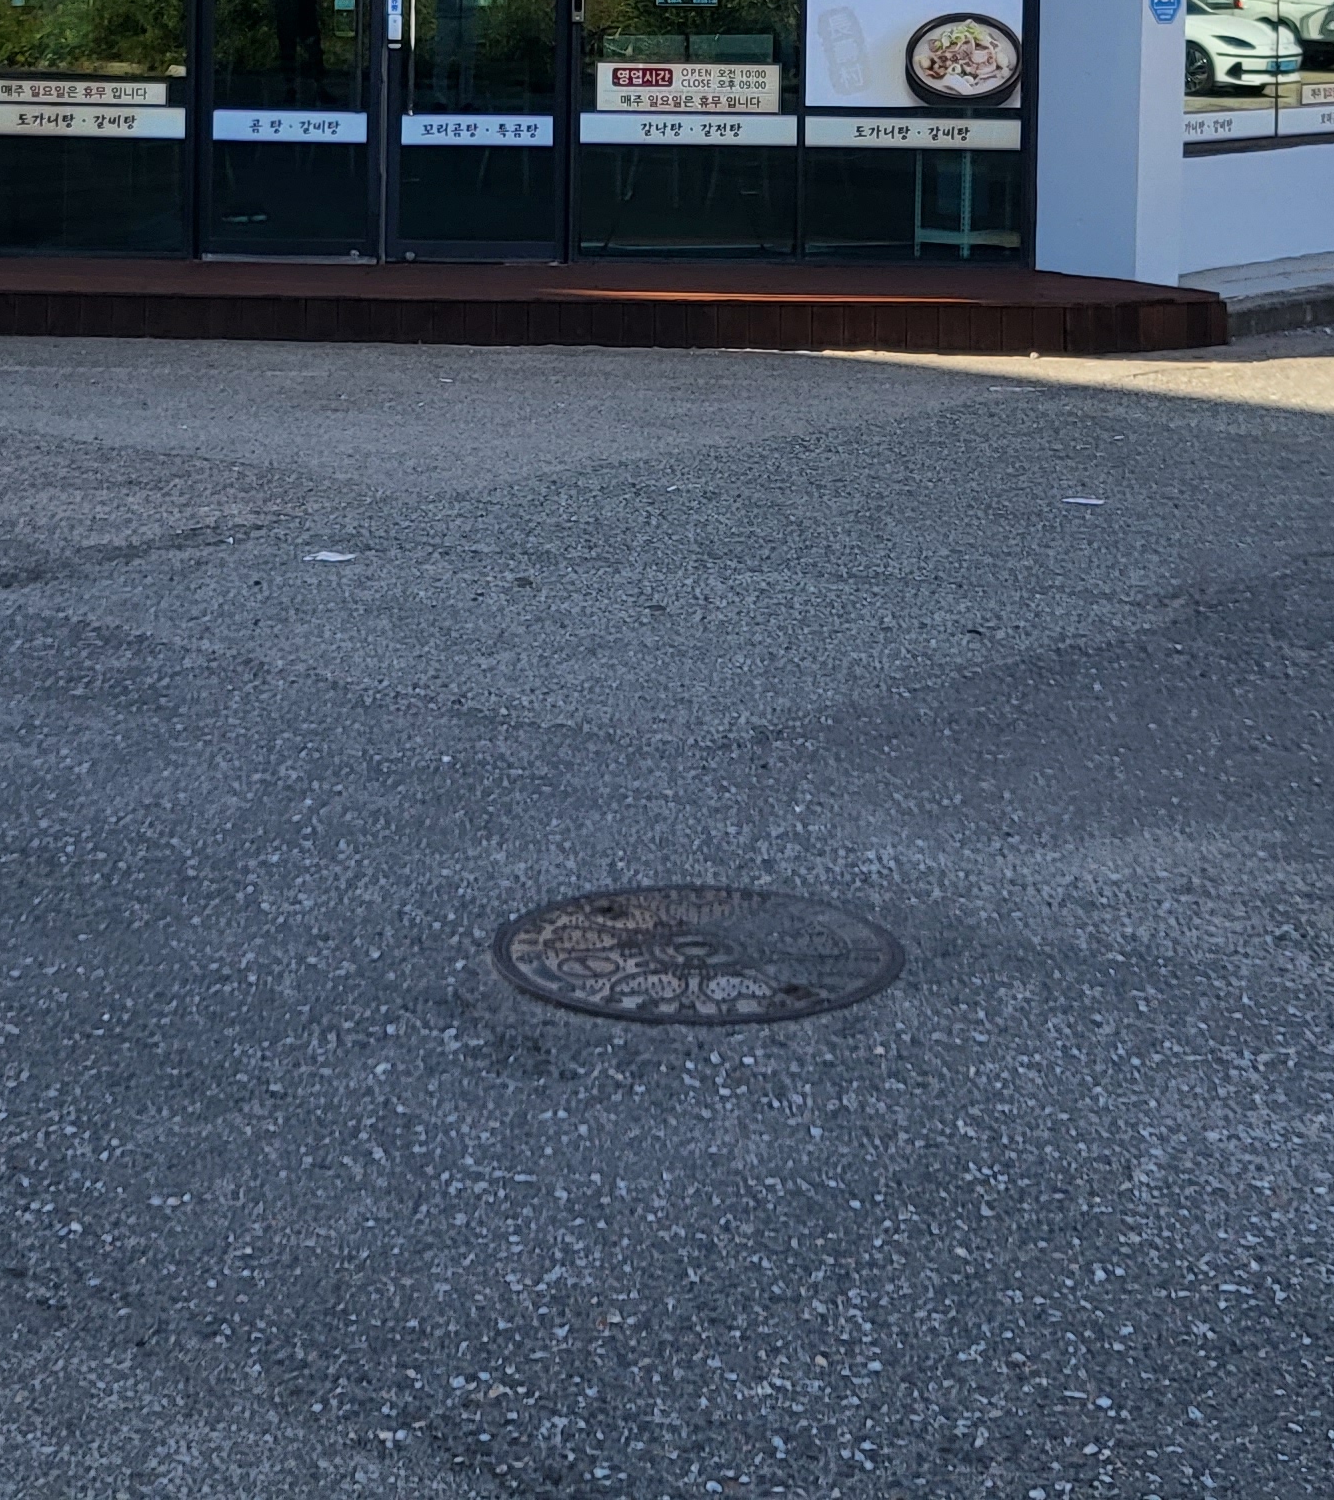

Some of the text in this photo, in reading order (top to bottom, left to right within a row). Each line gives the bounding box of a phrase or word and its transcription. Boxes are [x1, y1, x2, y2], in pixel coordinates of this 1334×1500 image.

[615, 67, 767, 86] 영업시간 OPEN 오전 10:00
[680, 78, 767, 90] CLOSE 오후 09:00
[0, 84, 148, 101] 매주 일요일은 휴무 입니다
[620, 94, 762, 109] 매주 일요일은 휴무 입니다
[16, 113, 138, 130] 도가니탕 갈비탕
[299, 120, 341, 136] 갈비탕
[640, 122, 744, 138] 갈낙탕 갈전탕
[421, 122, 541, 139] 꼬리곰탕 특곰탕
[853, 124, 971, 143] 도가니탕 갈비탕
